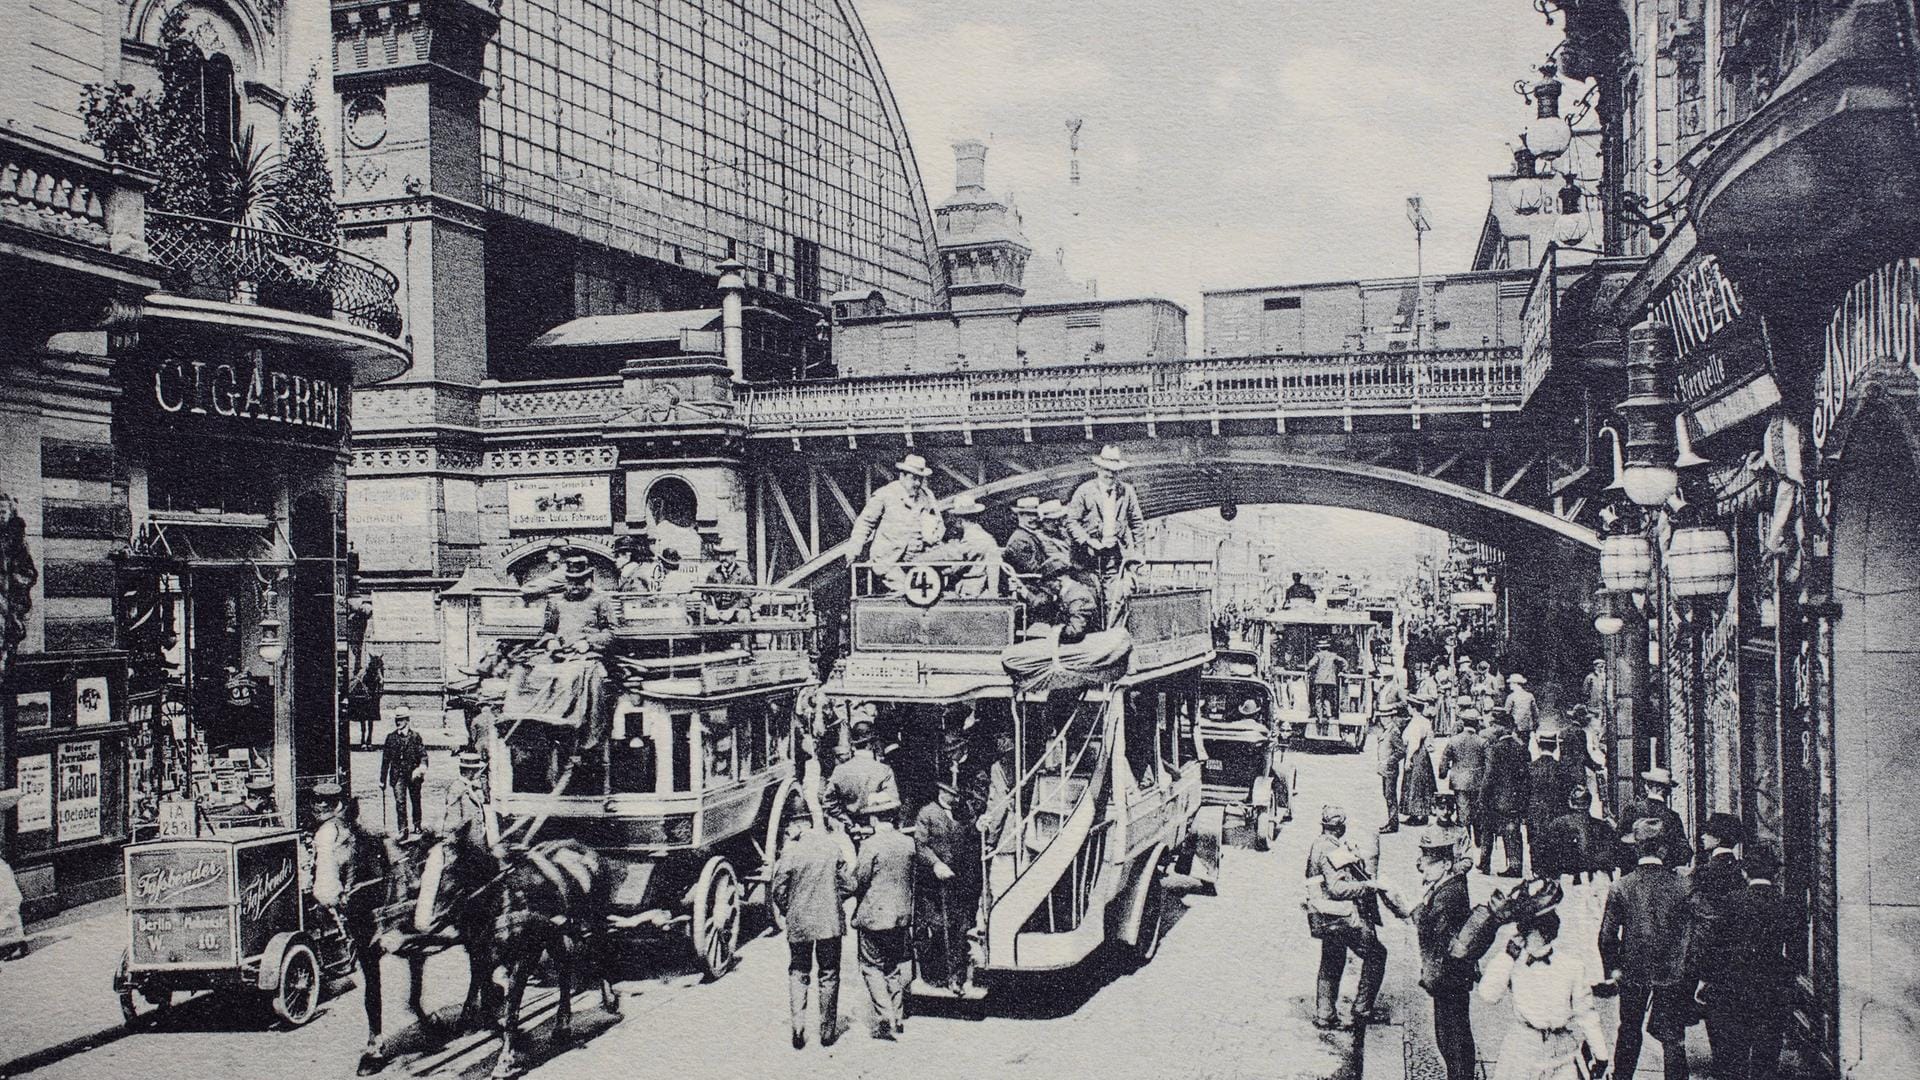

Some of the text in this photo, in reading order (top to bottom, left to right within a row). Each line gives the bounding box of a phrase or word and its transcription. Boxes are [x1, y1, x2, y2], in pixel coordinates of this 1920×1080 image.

[155, 350, 338, 431] CIGARREN
[910, 570, 934, 599] 4
[138, 916, 172, 932] Berlin
[147, 934, 163, 951] W
